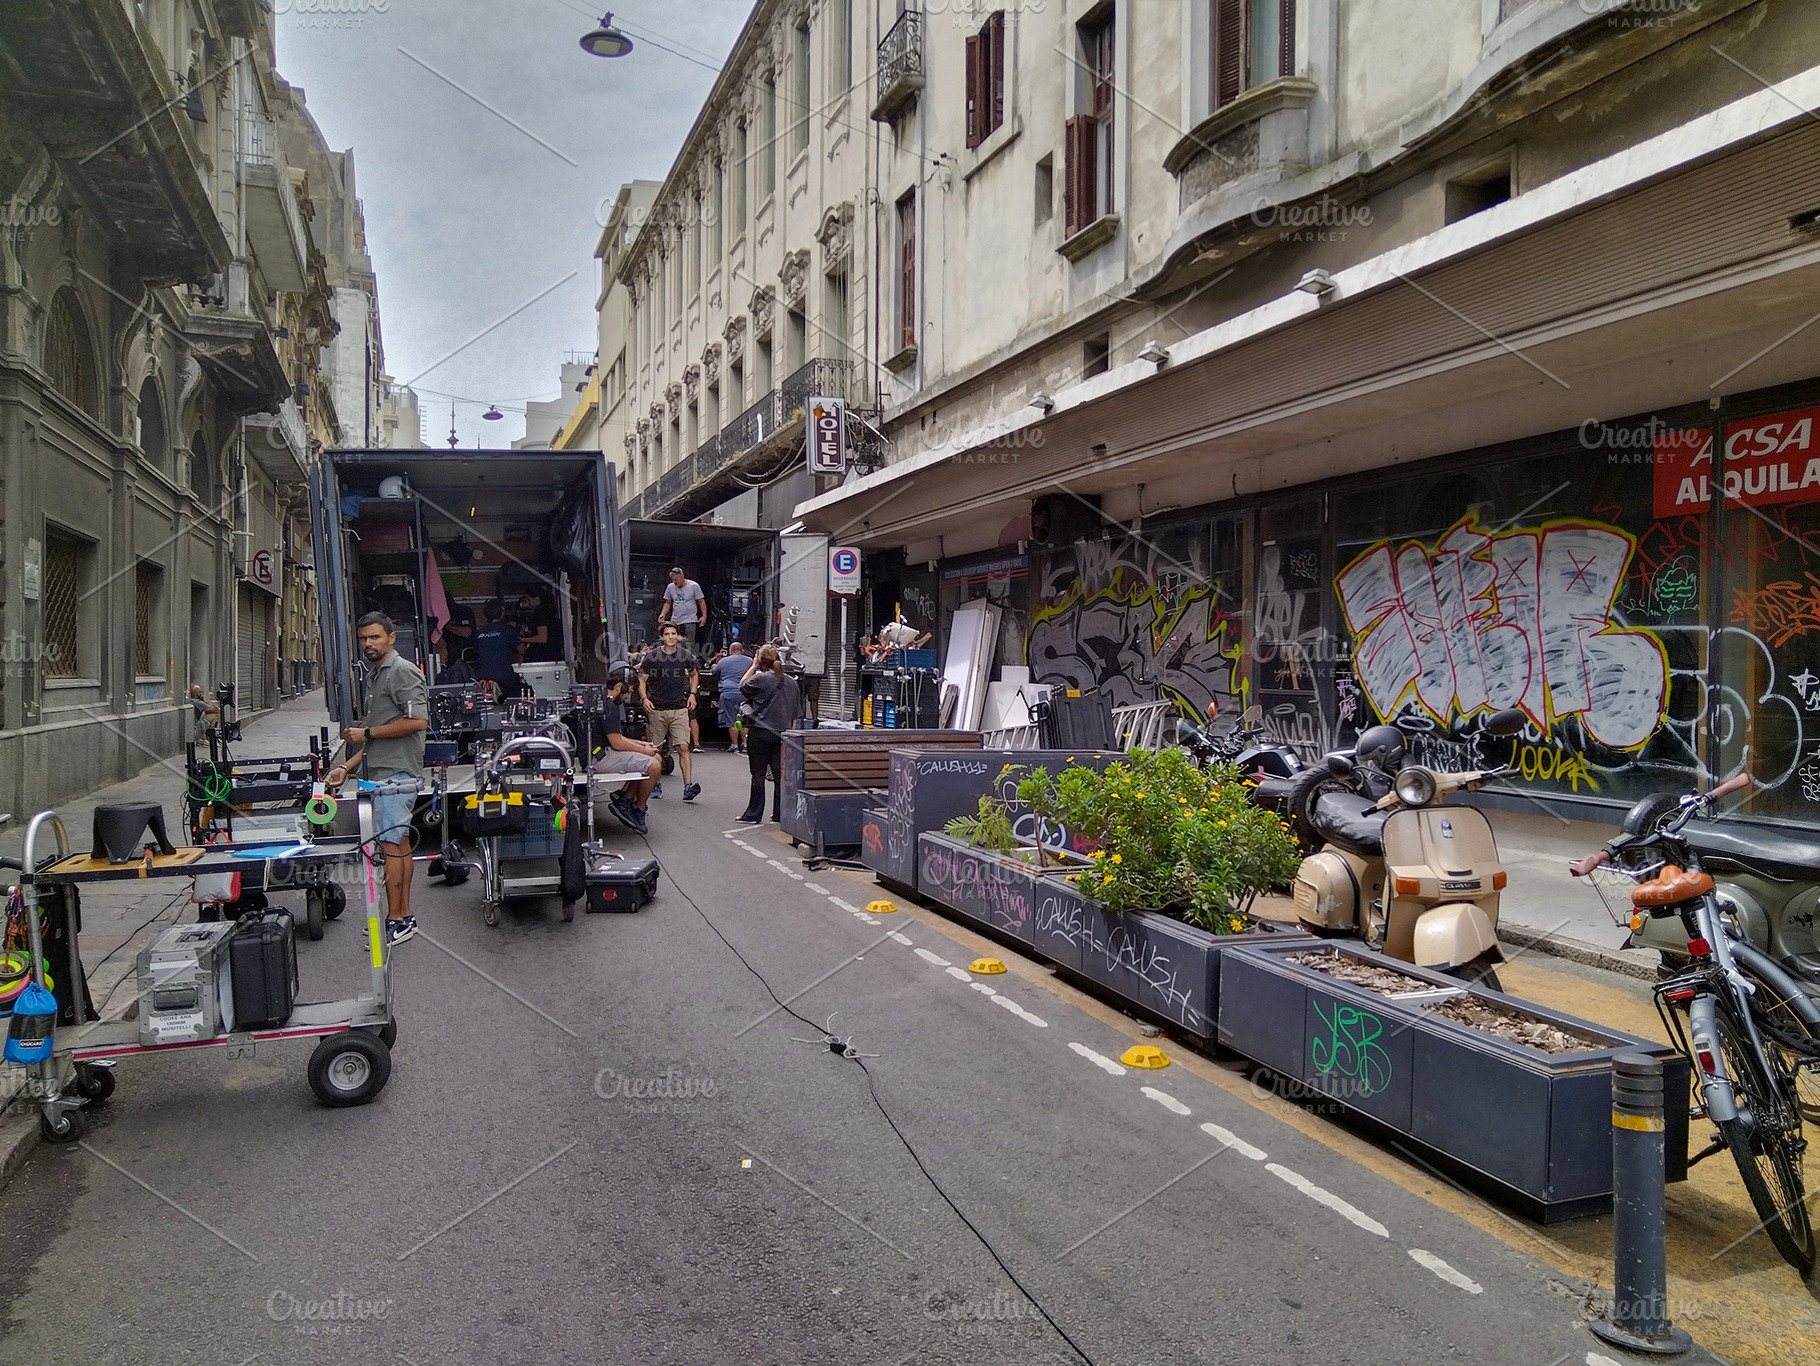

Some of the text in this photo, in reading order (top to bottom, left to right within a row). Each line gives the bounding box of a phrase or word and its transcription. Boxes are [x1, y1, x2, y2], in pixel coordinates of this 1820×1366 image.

[1689, 417, 1813, 467] ACSA
[1675, 457, 1820, 506] ALQUILA
[841, 554, 852, 570] E
